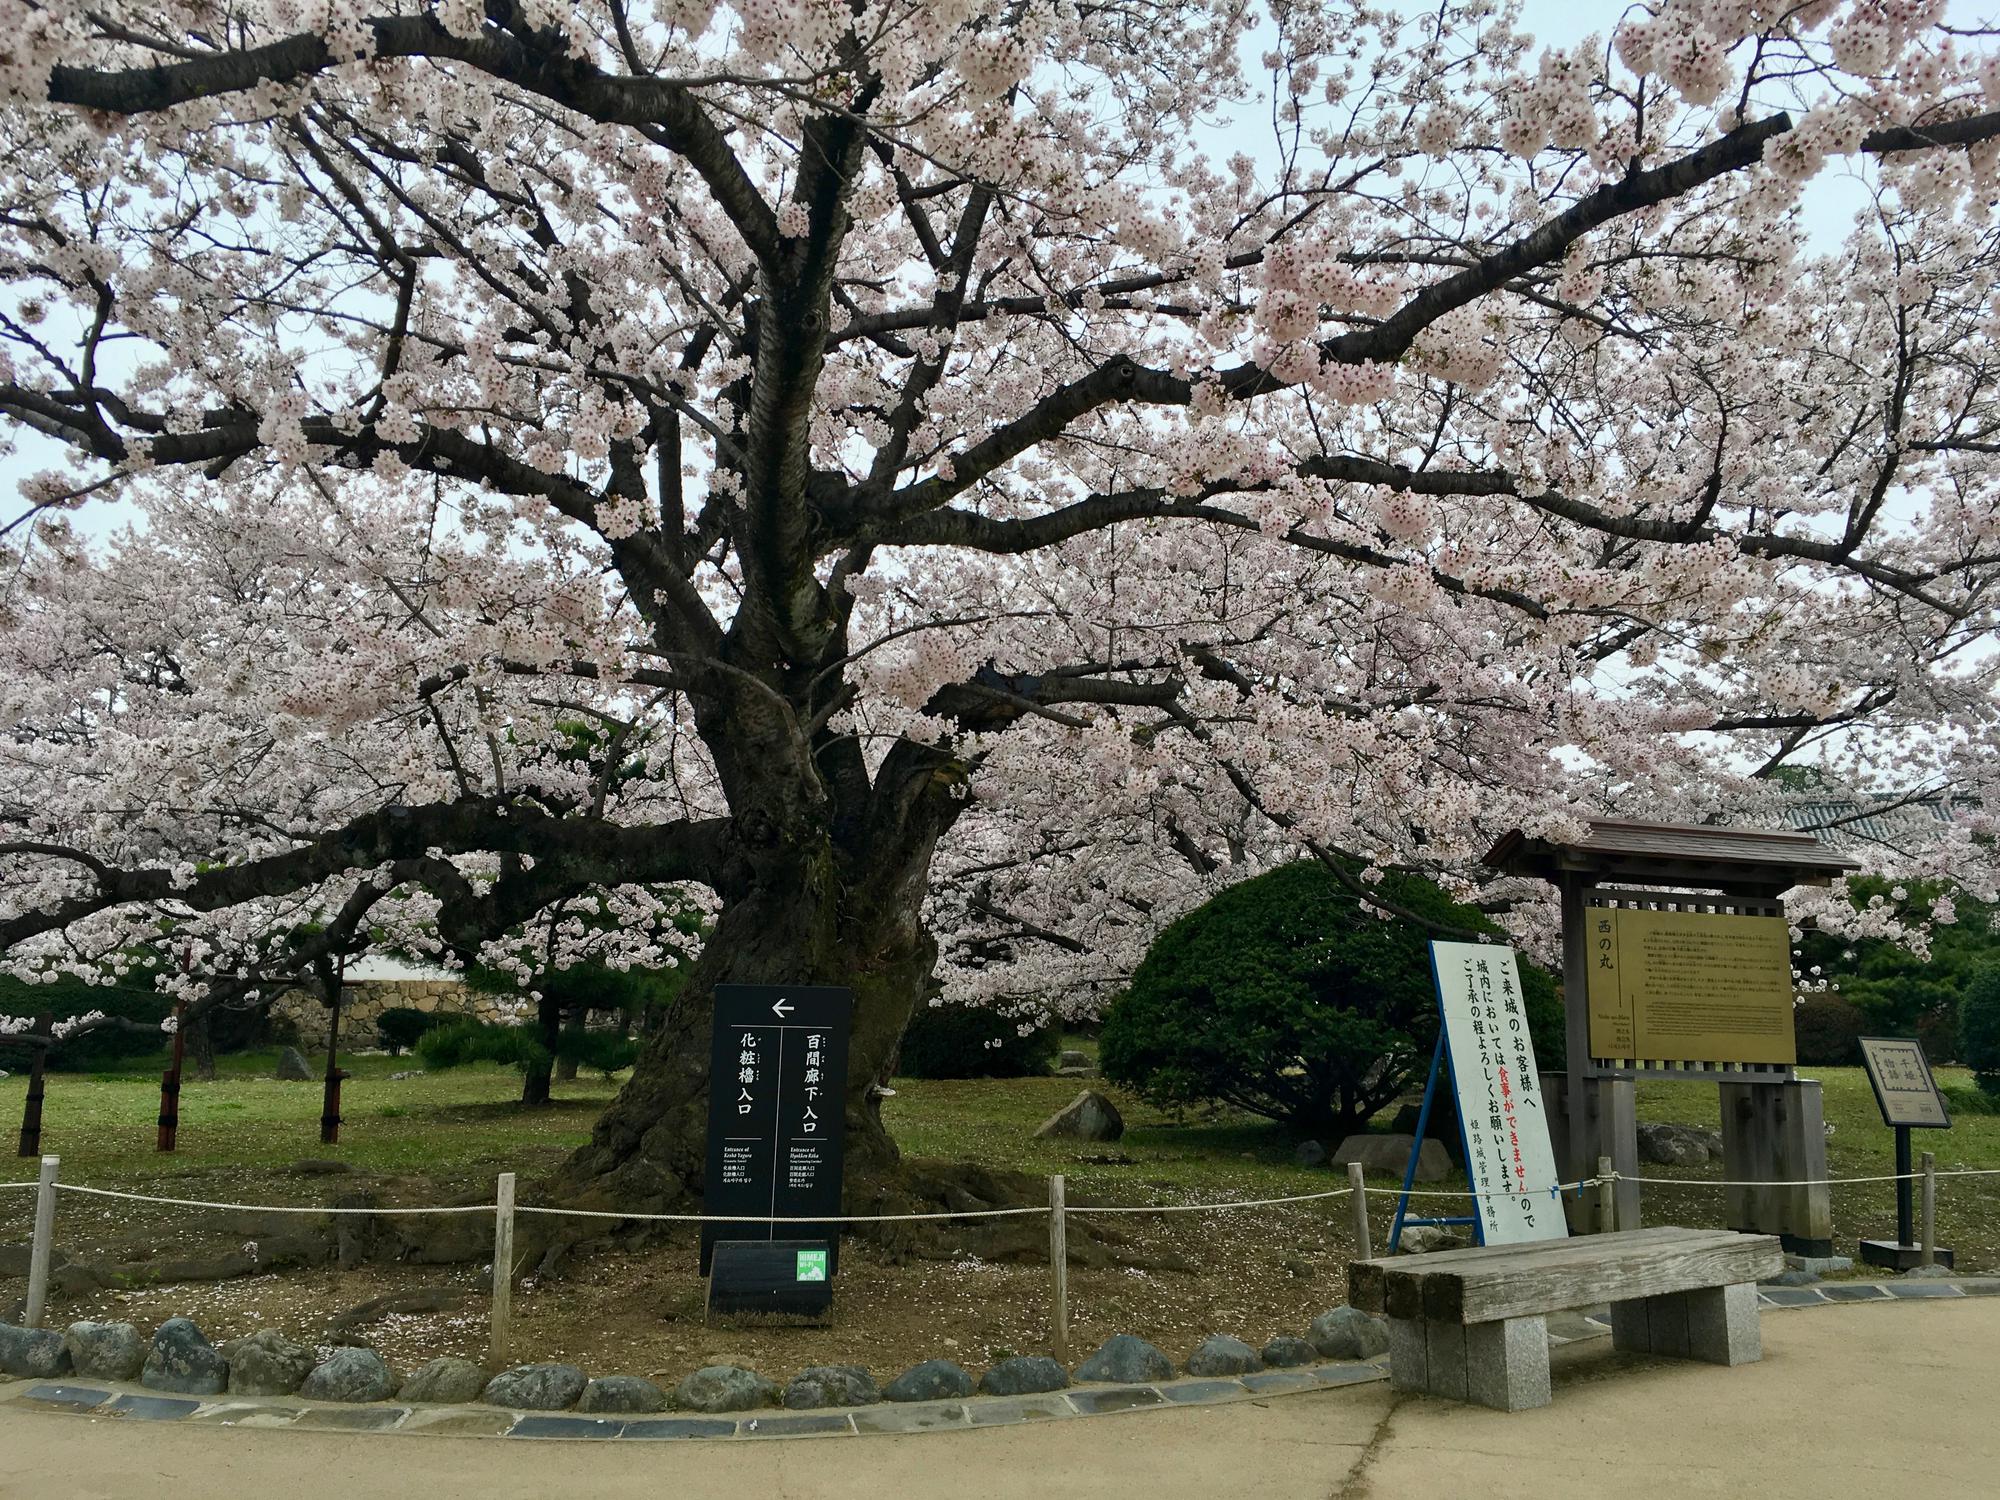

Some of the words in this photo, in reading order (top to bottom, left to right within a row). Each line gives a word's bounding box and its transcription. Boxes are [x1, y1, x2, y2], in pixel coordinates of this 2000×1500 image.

[1598, 919, 1614, 970] 西の丸
[737, 1032, 757, 1115] 化粧櫓入口
[1499, 959, 1536, 1109] ご来城のお客様へ
[802, 1033, 821, 1133] 百間廊下入口
[1476, 959, 1535, 1229] 城内においては食事ができませんので
[799, 1252, 825, 1261] HIMEJI
